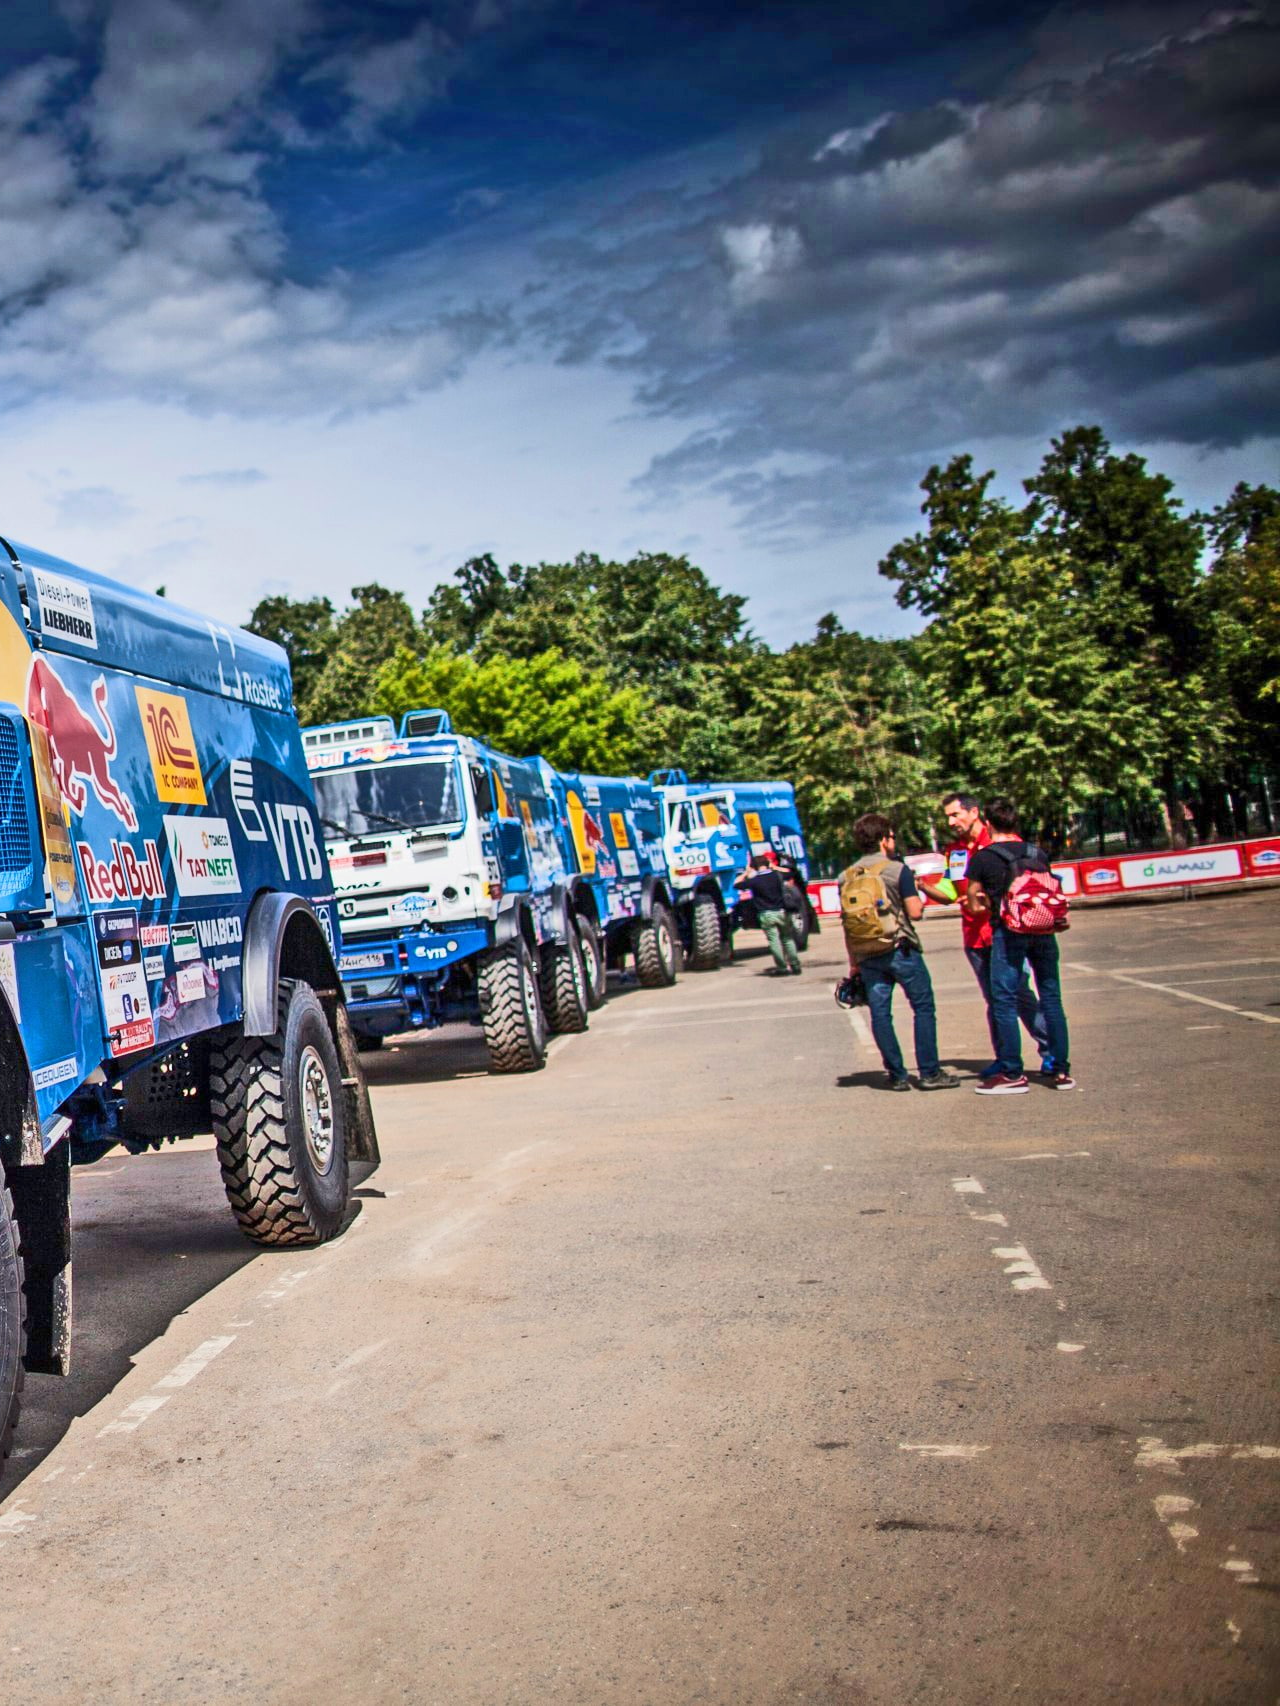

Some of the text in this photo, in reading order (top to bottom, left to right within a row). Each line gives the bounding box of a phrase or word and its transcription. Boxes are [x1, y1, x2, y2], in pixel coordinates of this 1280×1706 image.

[43, 607, 94, 640] LIEBHERR
[242, 671, 283, 710] Rostec
[162, 774, 200, 791] 1C COMPANY
[263, 801, 322, 881] VTB
[77, 840, 166, 901] Red Bull
[186, 858, 234, 878] TATNEFT
[1157, 860, 1216, 875] ALMALY
[143, 927, 168, 946] LOCTITE
[198, 916, 243, 948] WABCO
